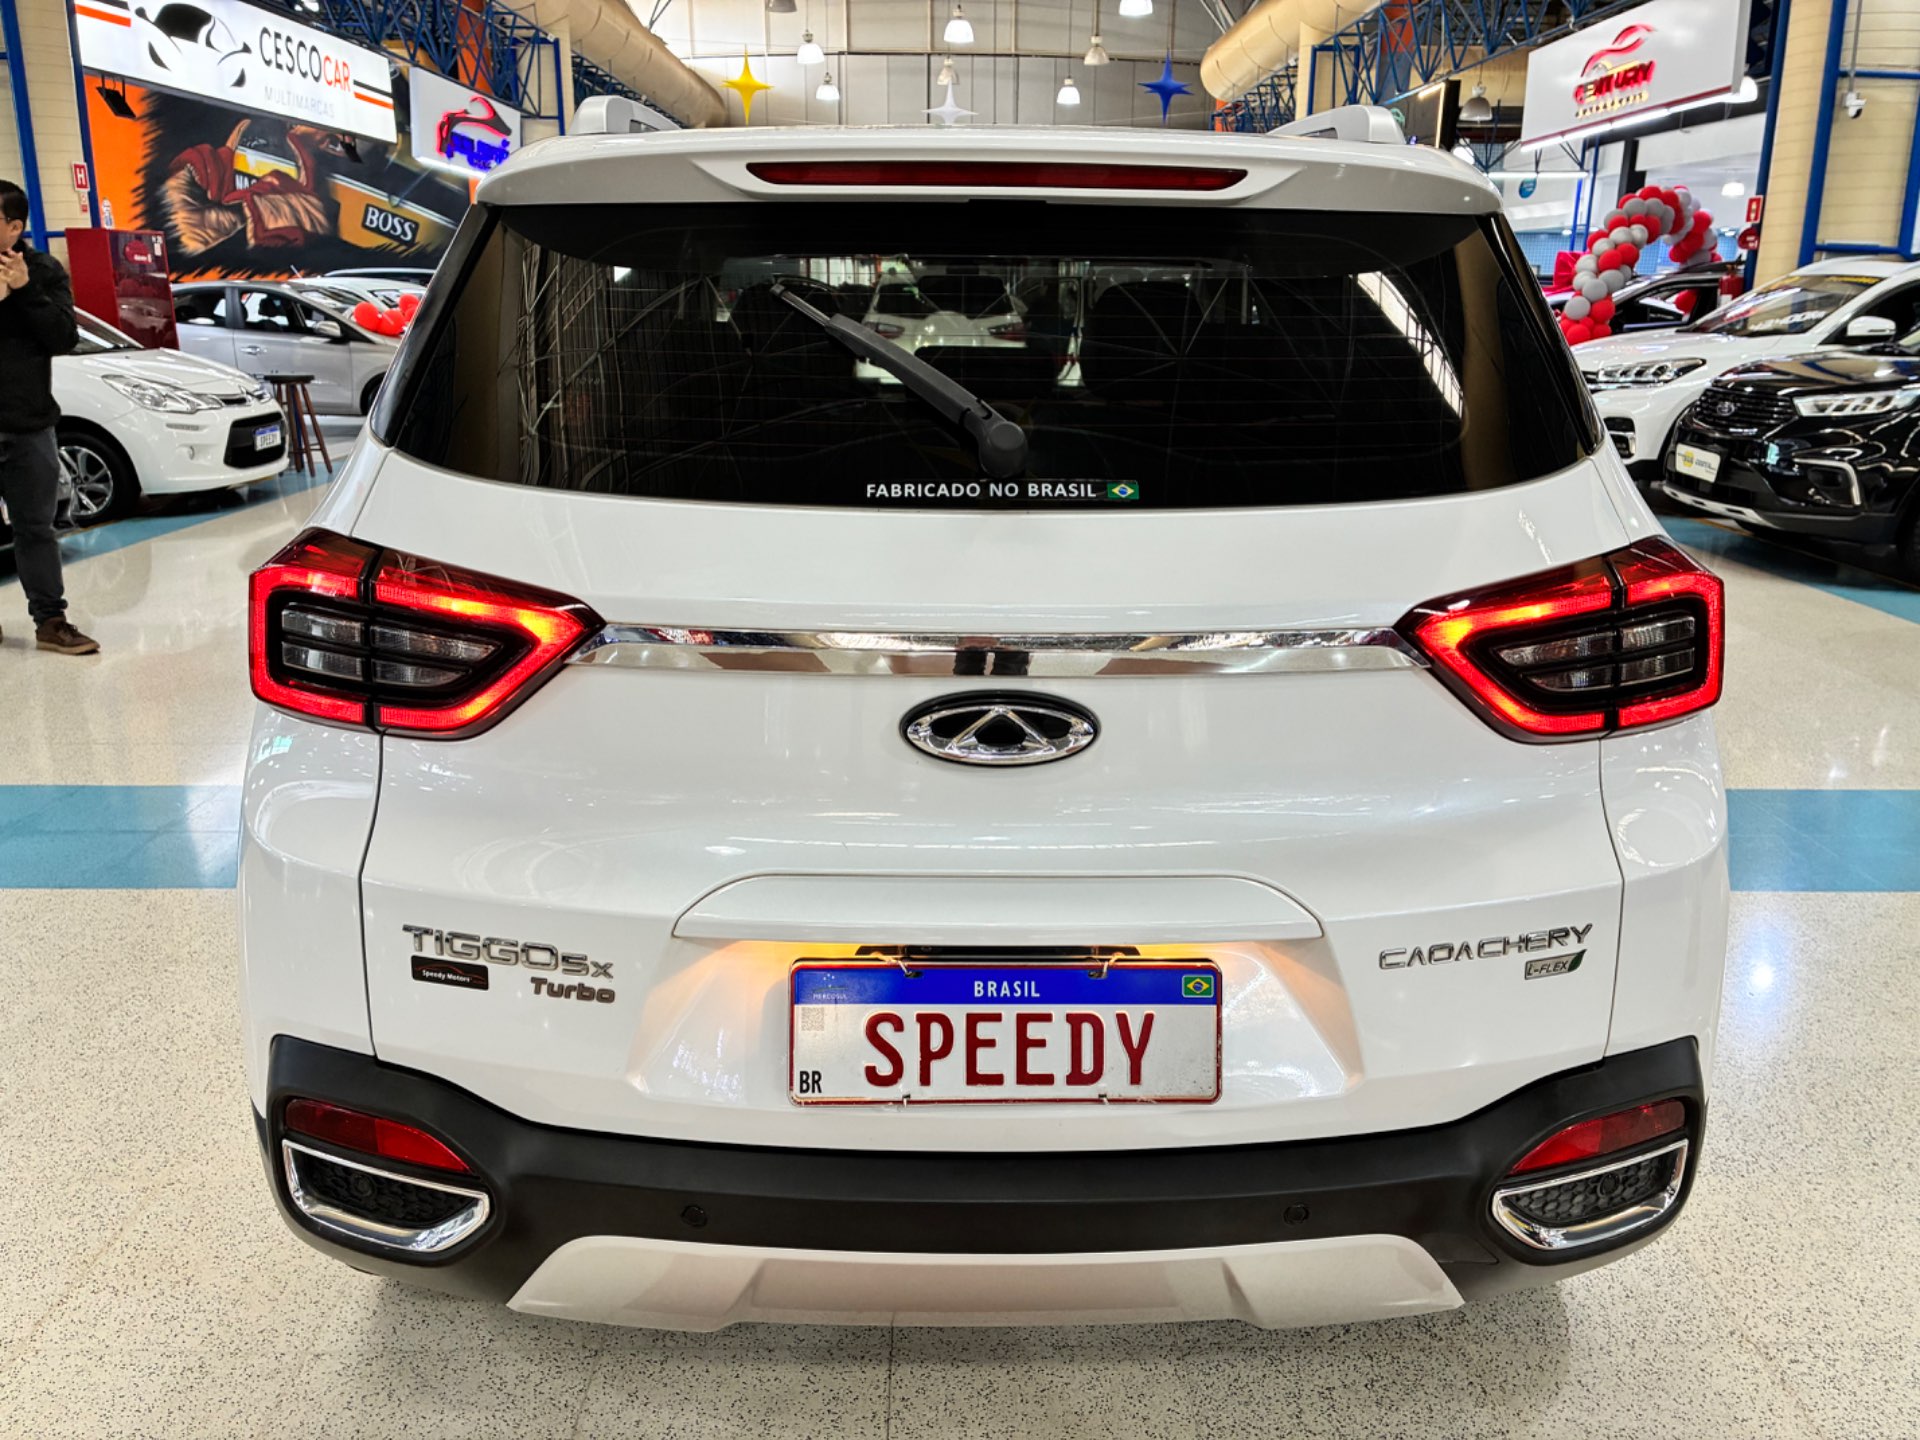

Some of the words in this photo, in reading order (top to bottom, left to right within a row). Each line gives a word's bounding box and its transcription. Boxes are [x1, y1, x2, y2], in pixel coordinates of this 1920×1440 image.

[75, 166, 87, 186] H
[365, 206, 416, 242] BOSS
[866, 483, 981, 498] FABRICADO
[989, 483, 1019, 497] NO
[1028, 483, 1096, 497] BRASIL
[422, 969, 446, 980] Speedy
[447, 973, 471, 983] Motors
[531, 977, 615, 1003] Turbo
[973, 980, 1041, 998] BRASIL
[864, 1012, 1156, 1087] SPEEDY
[799, 1070, 823, 1094] BR
